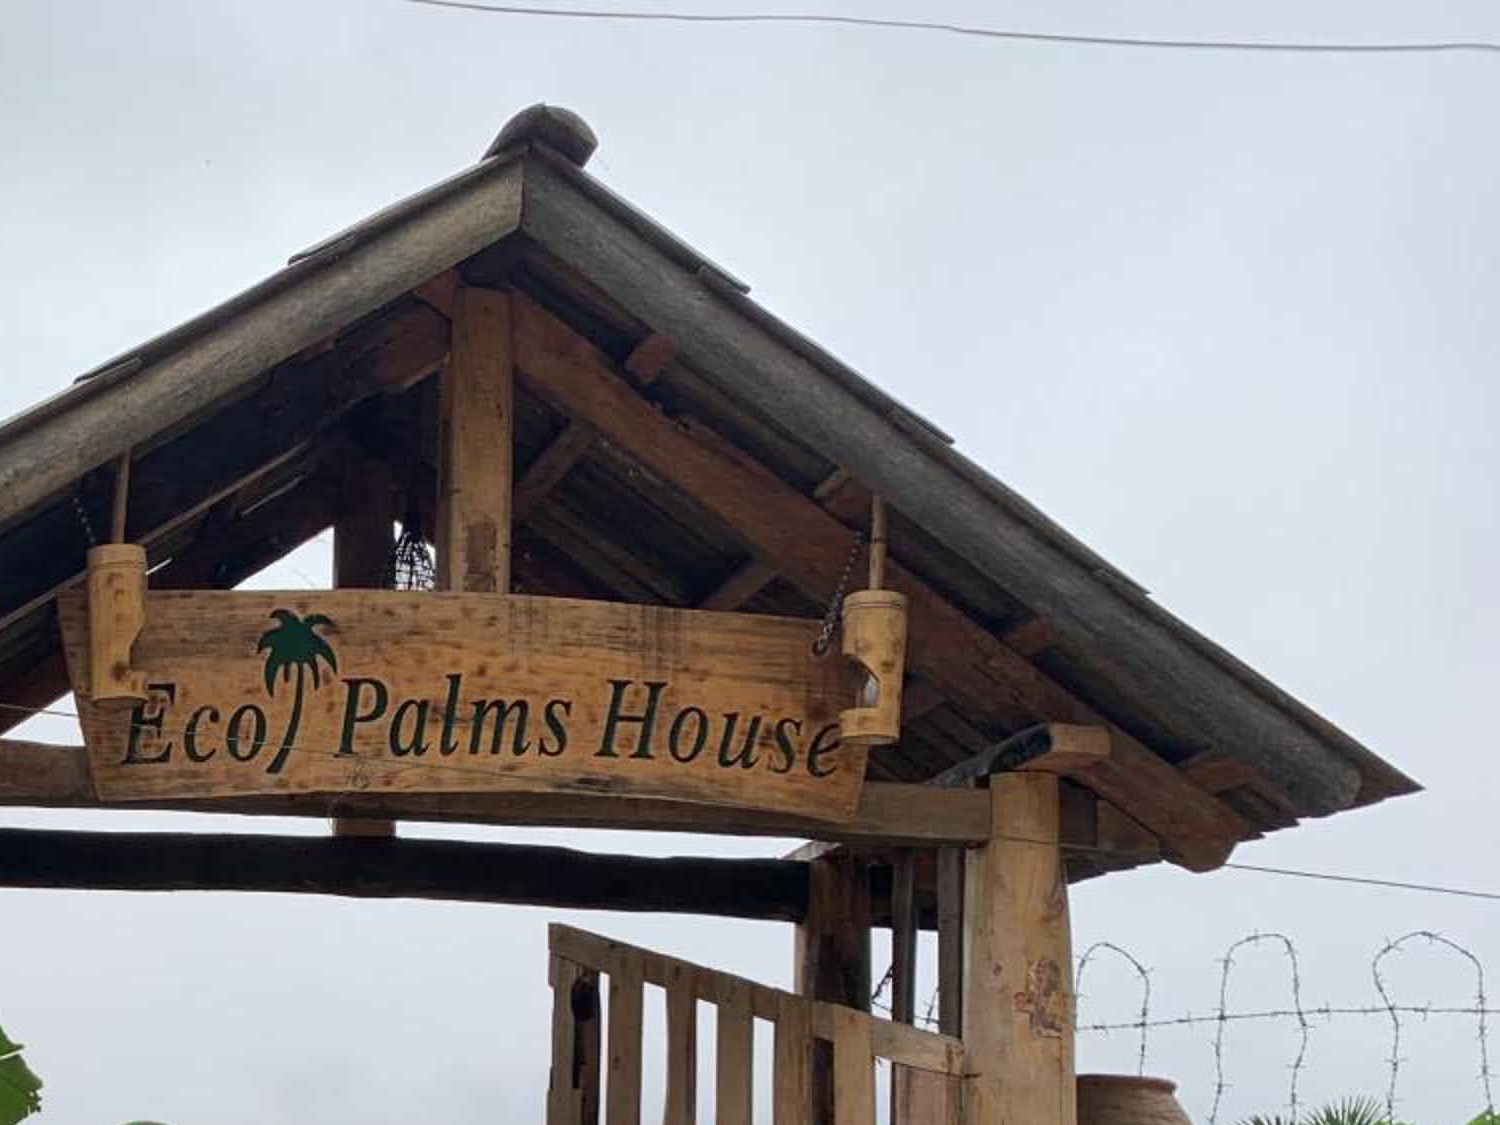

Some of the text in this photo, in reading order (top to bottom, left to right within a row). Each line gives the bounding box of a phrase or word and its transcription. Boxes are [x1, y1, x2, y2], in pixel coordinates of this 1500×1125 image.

[121, 674, 843, 777] Eco Palms House
